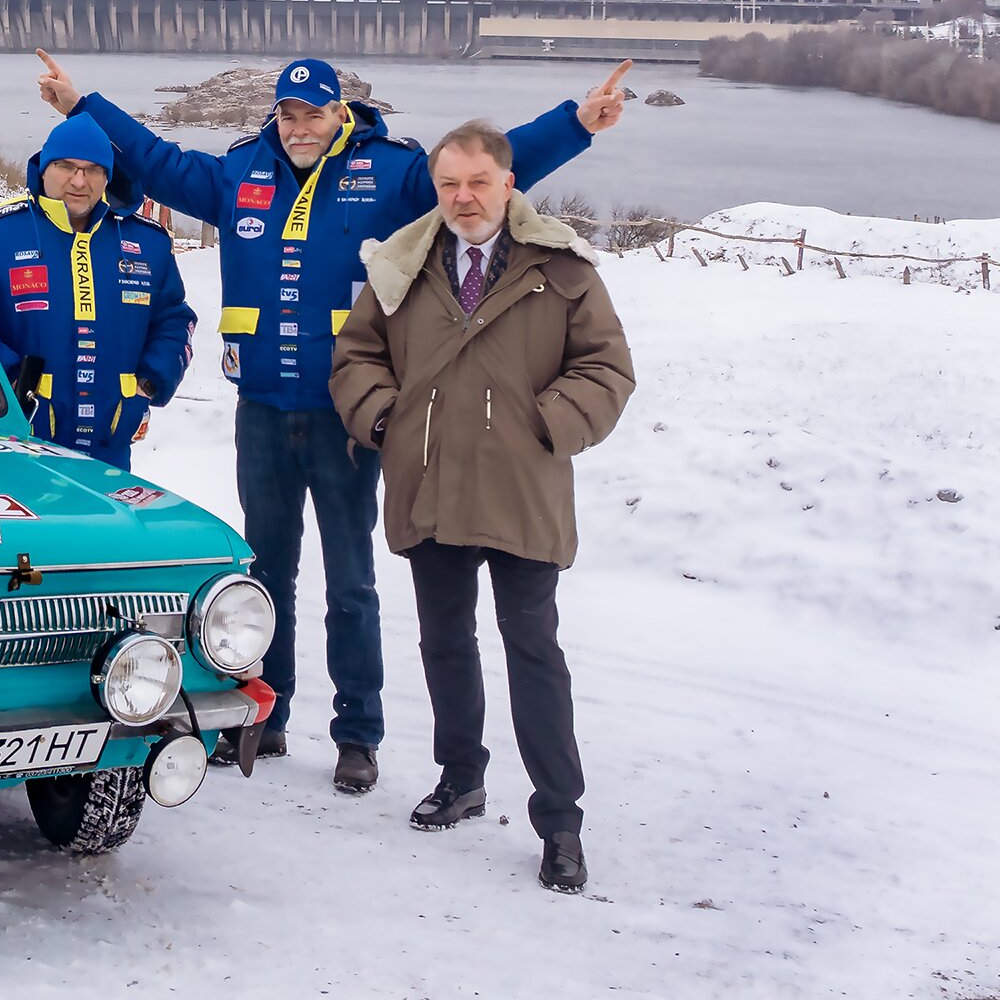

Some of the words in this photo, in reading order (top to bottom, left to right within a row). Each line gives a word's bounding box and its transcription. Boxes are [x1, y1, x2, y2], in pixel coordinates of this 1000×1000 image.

[238, 197, 271, 206] MONACO
[238, 224, 262, 233] eurol
[76, 239, 92, 313] UKRAINE
[12, 282, 47, 291] MONACO
[44, 729, 98, 762] HT
